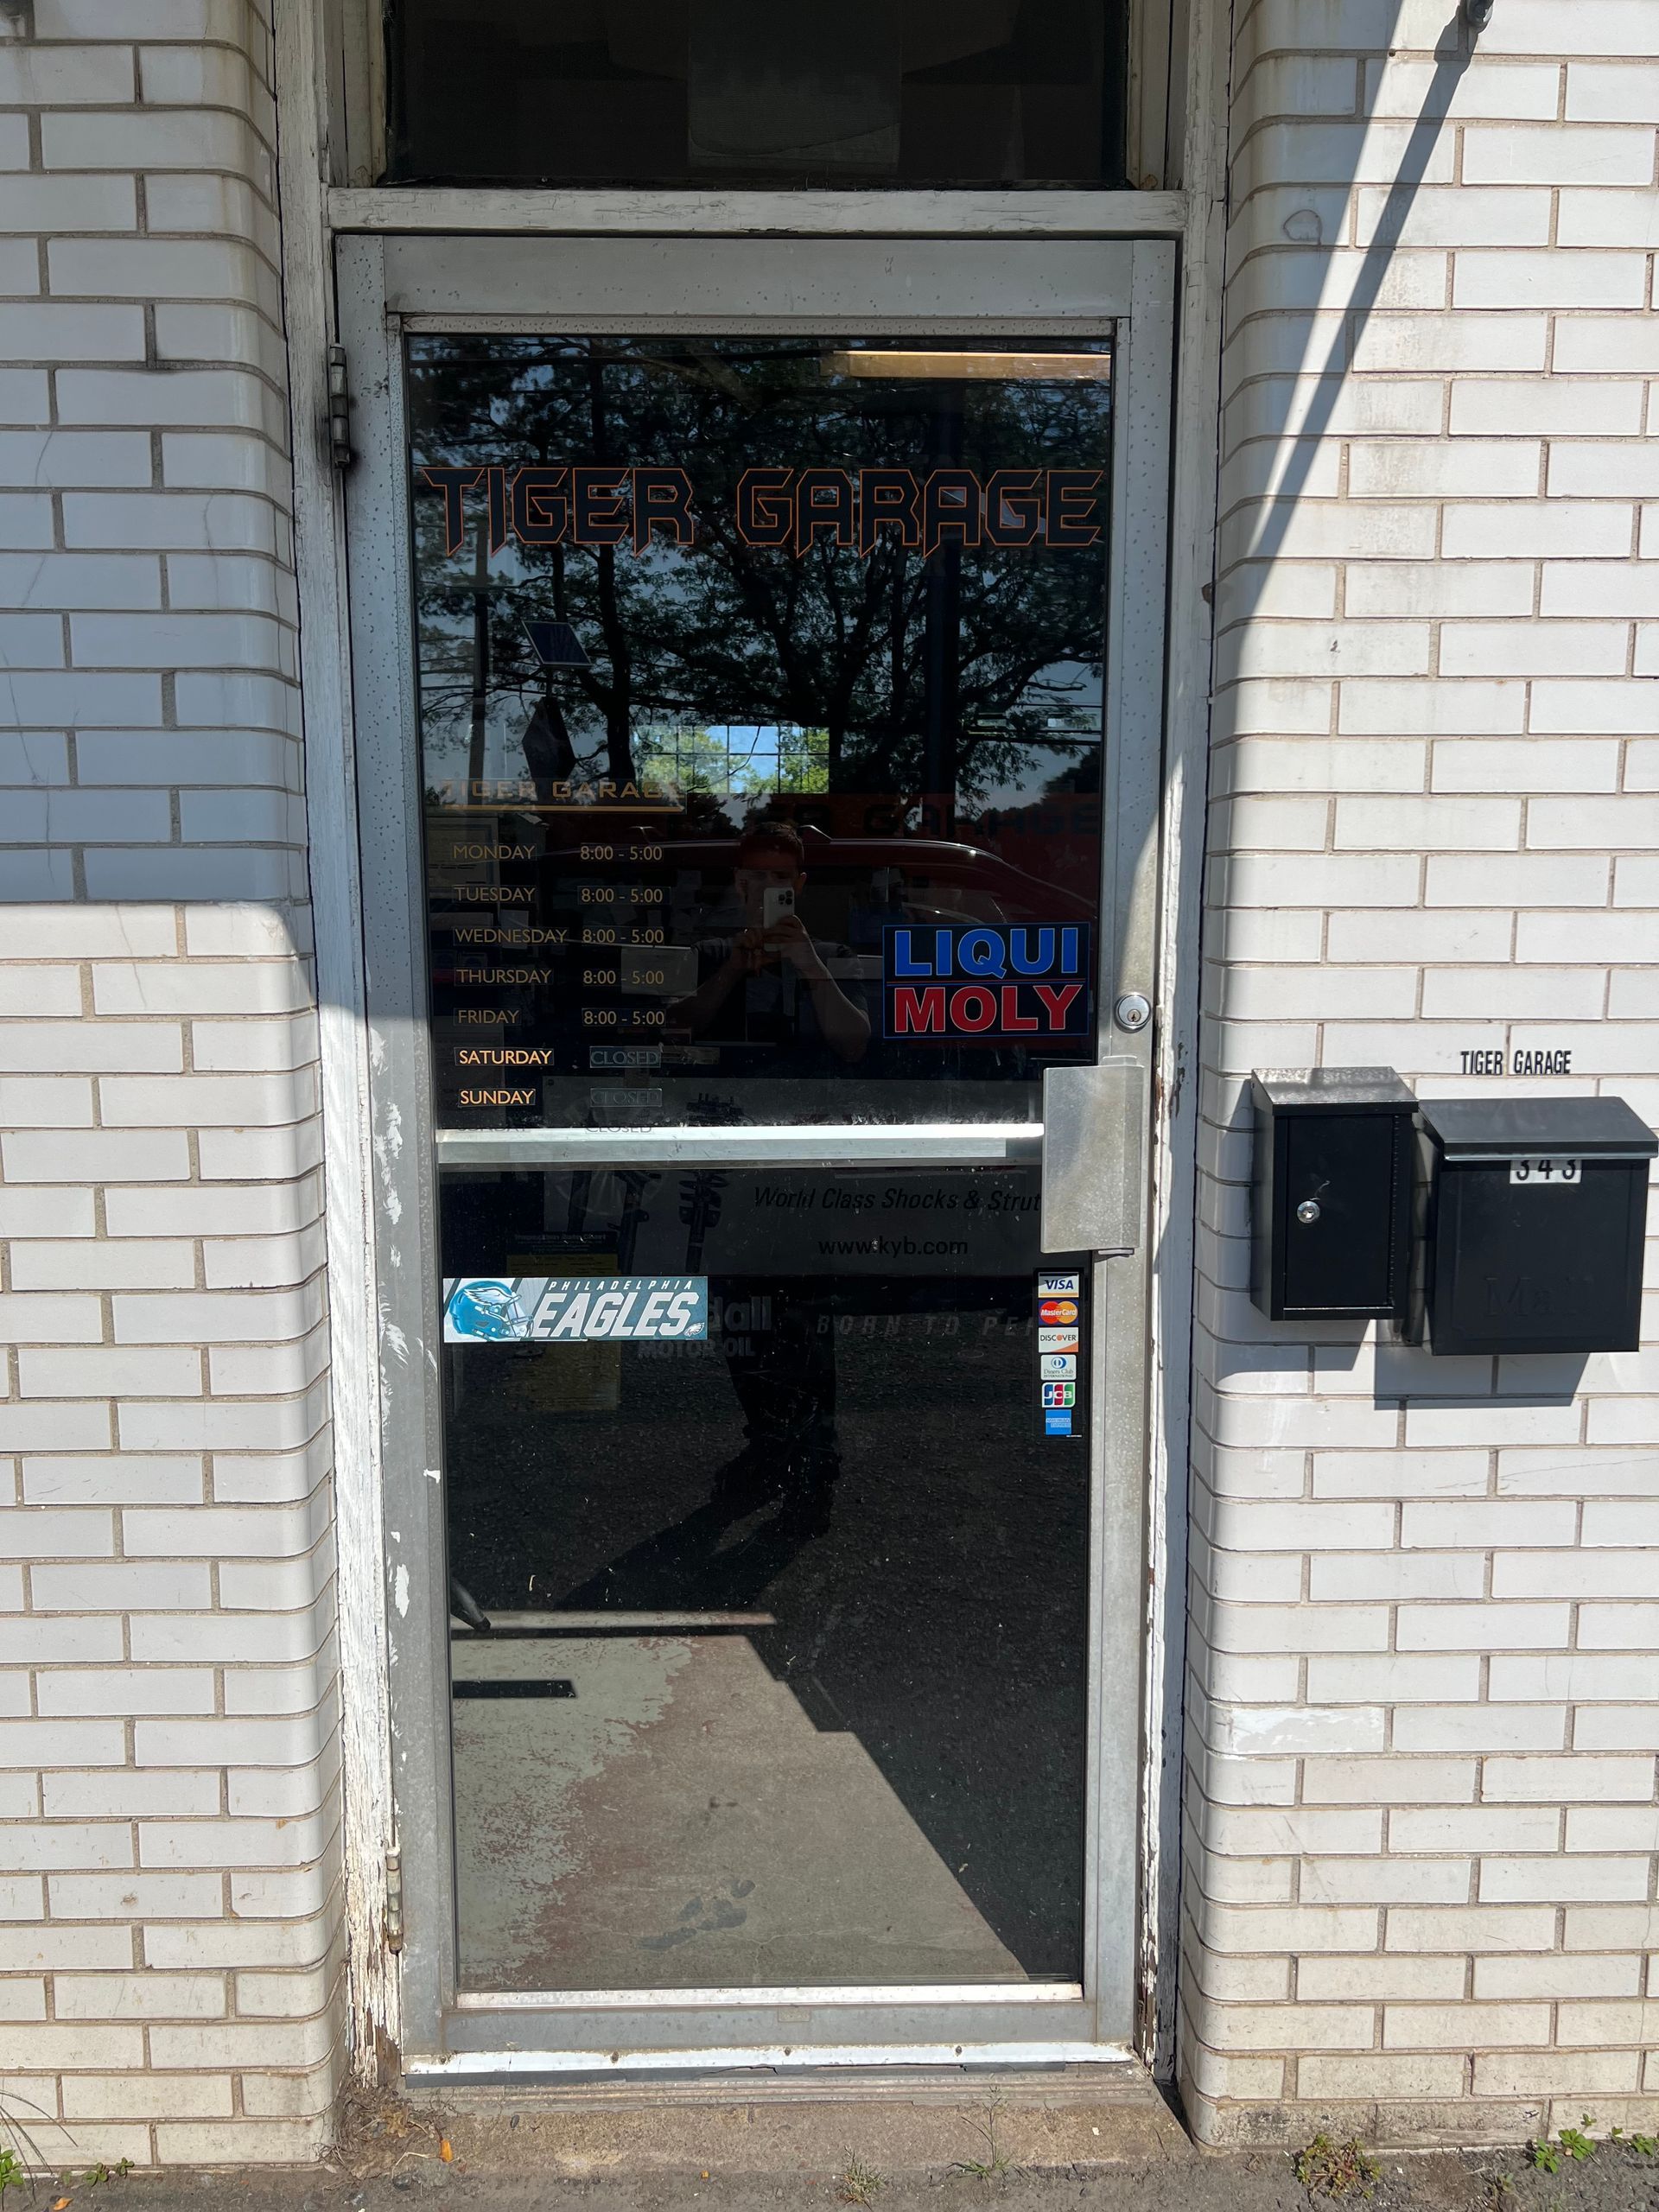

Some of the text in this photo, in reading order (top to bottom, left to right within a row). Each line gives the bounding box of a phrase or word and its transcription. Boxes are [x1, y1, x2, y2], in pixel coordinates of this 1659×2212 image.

[423, 467, 1104, 558] TIGER GARAGE
[440, 779, 686, 800] TIGER GARAGE
[453, 844, 536, 861] MONDAY
[580, 846, 613, 861] 8:00
[629, 846, 663, 861] 5:00
[454, 887, 536, 902] TUESDAY
[581, 888, 614, 903] 8:00
[630, 888, 664, 903] 5:00
[454, 928, 568, 944] WEDNESDAY
[582, 929, 615, 944] 8:00
[631, 929, 664, 944] 5:00
[894, 928, 1078, 979] LIQUI
[456, 969, 553, 984] THURSDAY
[582, 970, 616, 985] 8:00
[632, 970, 664, 985] 5:00
[457, 1009, 520, 1025] FRIDAY
[583, 1010, 617, 1025] 8:00
[632, 1010, 665, 1025] 5:00
[894, 984, 1083, 1033] MOLY
[459, 1050, 659, 1065] SATURDAY CLOSED
[1460, 1049, 1572, 1075] TIGER GARAGE
[459, 1090, 535, 1105] SUNDAY
[1516, 1160, 1576, 1180] 343
[754, 1186, 1041, 1211] World Class Shocks & Strut
[818, 1236, 969, 1258] www.kyb.com
[549, 1280, 692, 1291] PHILADELPHIA
[1044, 1280, 1073, 1289] VISA
[531, 1292, 699, 1338] EAGLES
[725, 1337, 757, 1357] OIL
